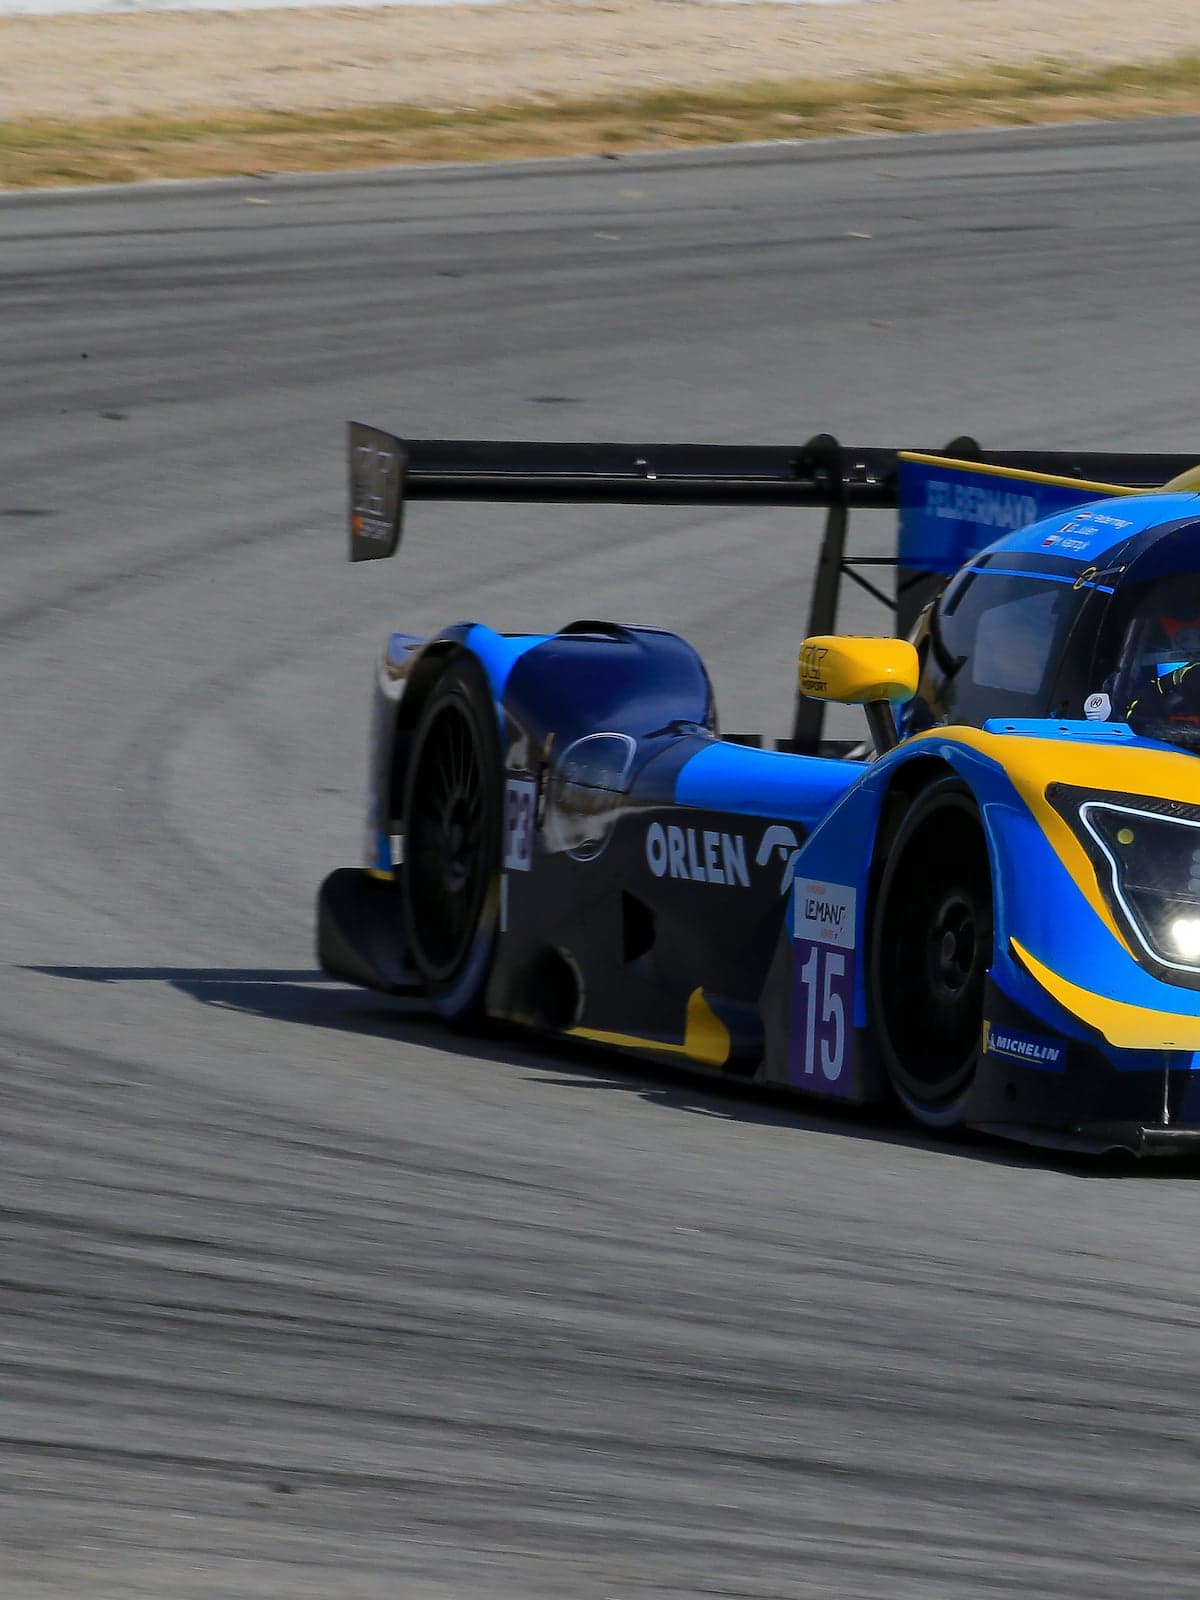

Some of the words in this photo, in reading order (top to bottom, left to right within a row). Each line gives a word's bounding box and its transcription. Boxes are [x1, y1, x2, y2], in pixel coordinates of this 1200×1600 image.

[646, 822, 751, 887] ORLEN
[801, 947, 845, 1081] 15
[996, 1035, 1060, 1061] MICHELIN
